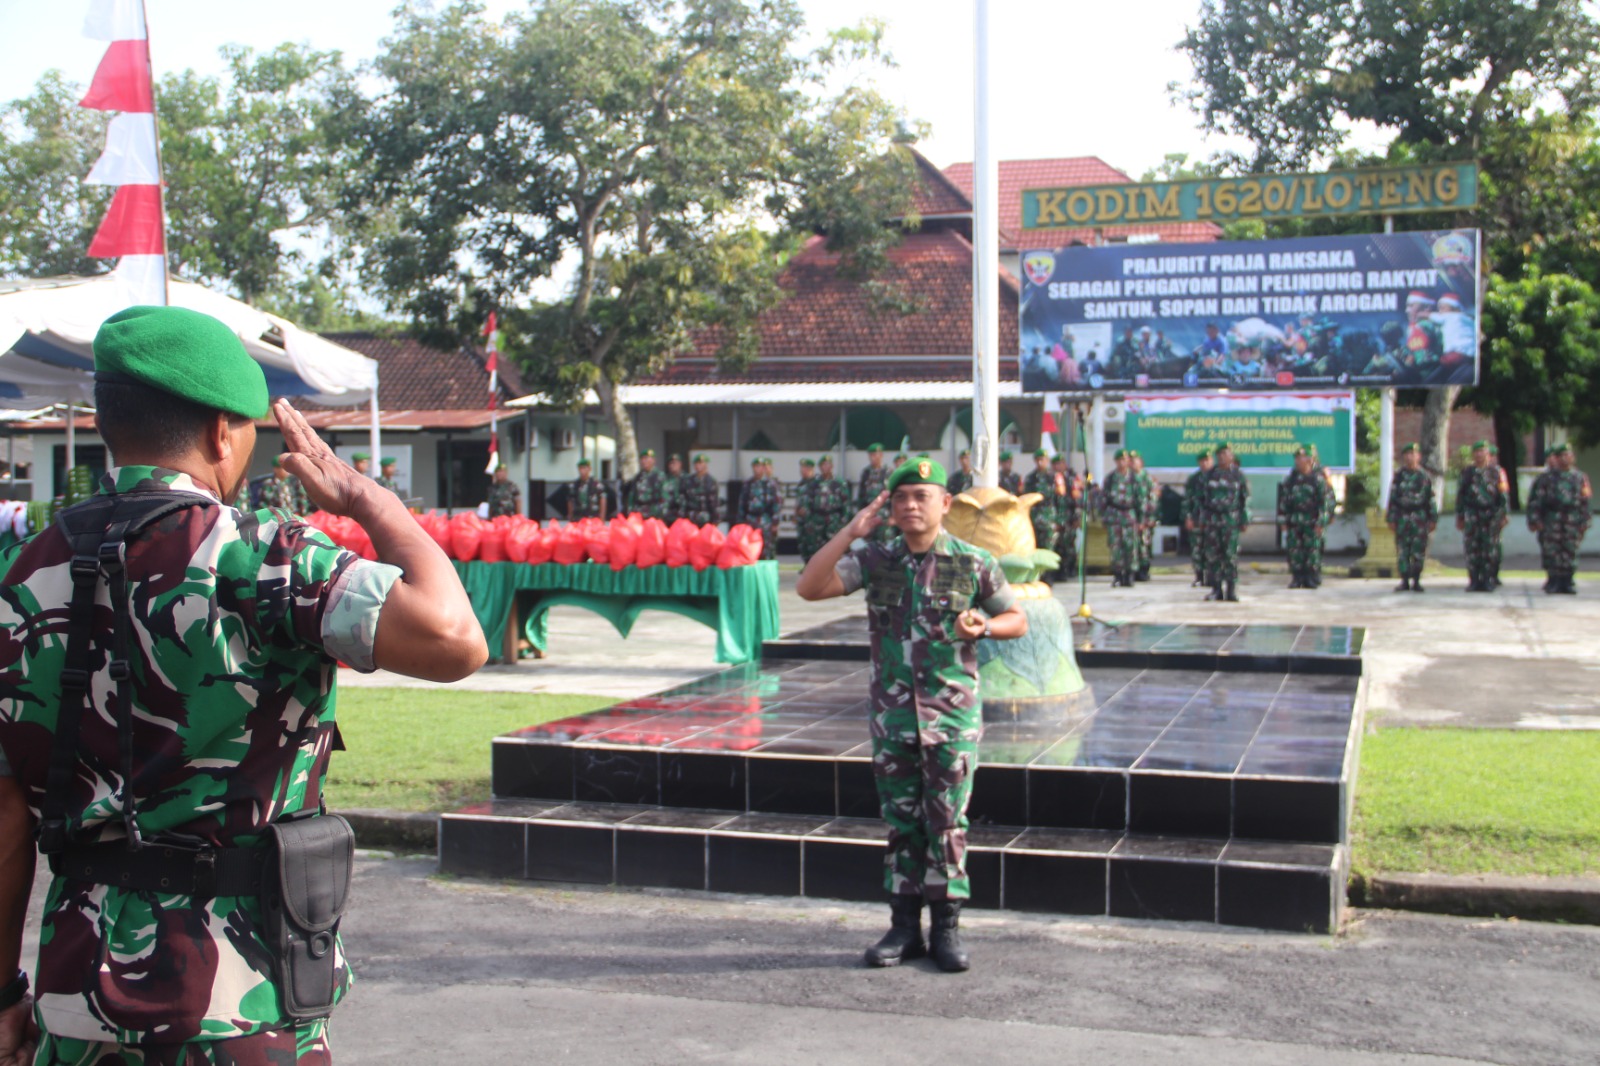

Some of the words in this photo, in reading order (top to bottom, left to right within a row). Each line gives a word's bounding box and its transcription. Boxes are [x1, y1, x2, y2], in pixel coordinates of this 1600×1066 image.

[1036, 185, 1181, 224] KODIM
[1196, 168, 1459, 216] 1620/LOTENG
[1123, 256, 1206, 275] PRAJURIT
[1210, 254, 1266, 273] PRAJA
[1269, 250, 1356, 270] RAKSAKA
[1048, 280, 1121, 299] SEBAGAI
[1124, 277, 1217, 297] PENGAYOM
[1221, 276, 1258, 293] DAN
[1262, 271, 1364, 292] PELINDUNG
[1367, 269, 1438, 288] RAKYAT
[1159, 299, 1218, 316] SOPAN
[1221, 298, 1259, 315] DAN
[1262, 296, 1318, 314] TIDAK
[1320, 293, 1397, 312] AROGAN
[1138, 416, 1183, 428] LATIHAN
[1185, 416, 1258, 427] PERORANGAN
[1299, 415, 1335, 427] UMUM
[1183, 429, 1206, 440] PUP
